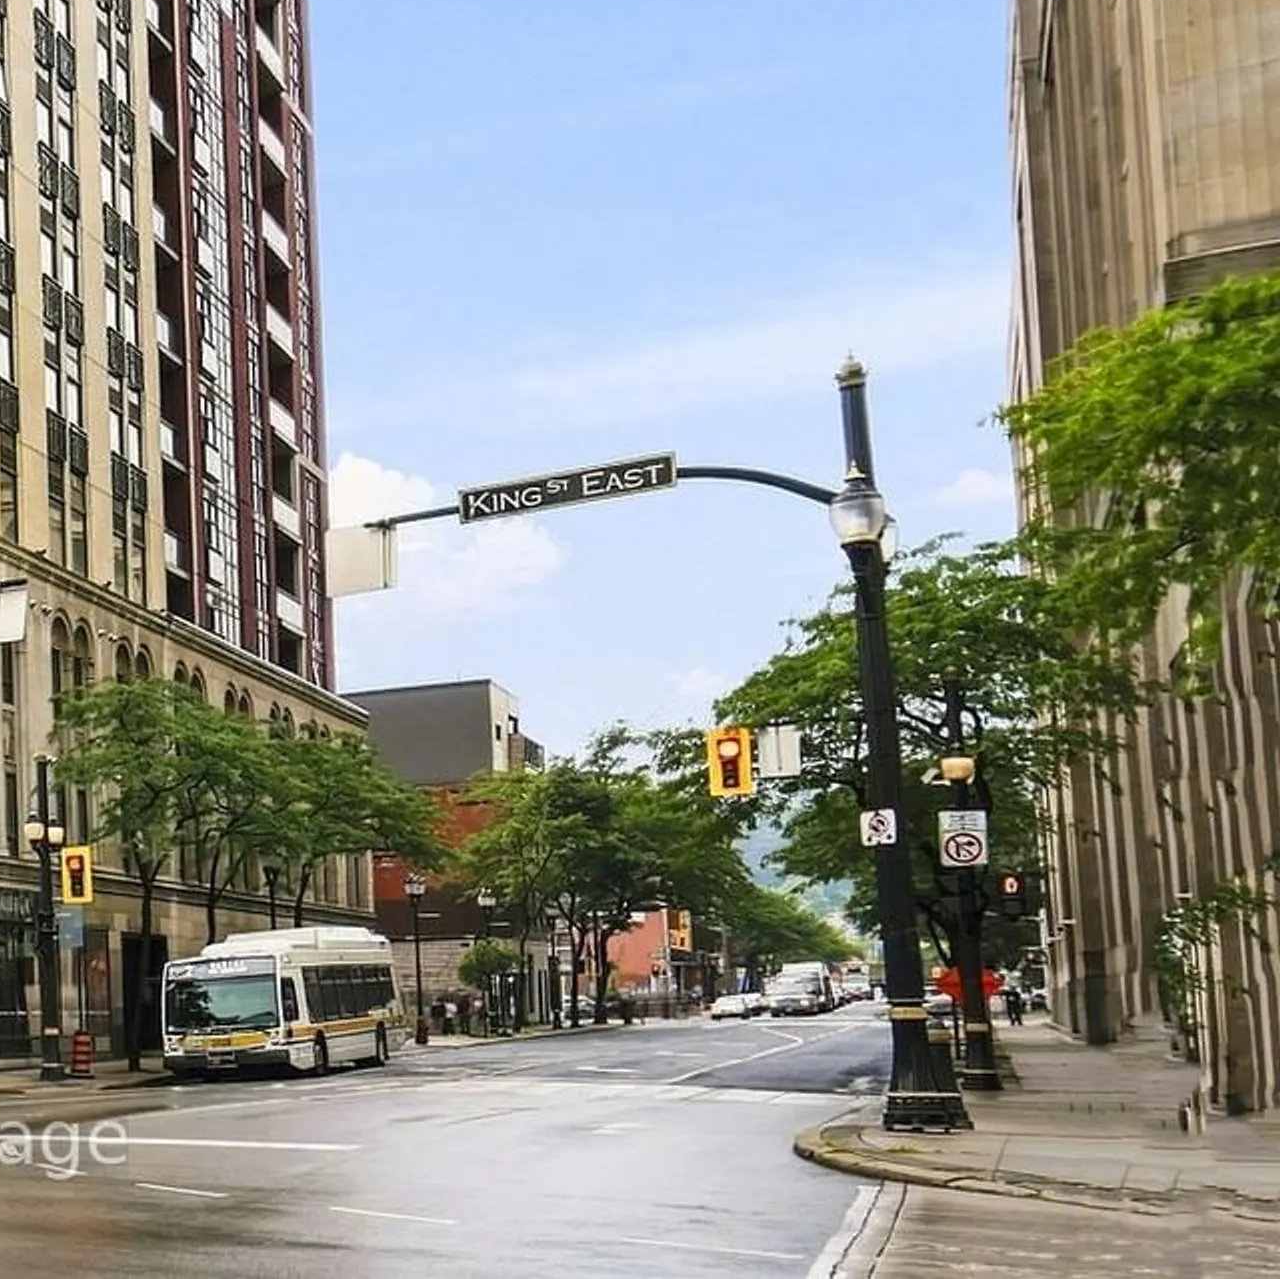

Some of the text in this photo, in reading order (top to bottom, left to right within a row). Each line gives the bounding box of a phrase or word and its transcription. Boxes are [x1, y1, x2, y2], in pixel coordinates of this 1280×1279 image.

[468, 464, 664, 517] KING ST EAST
